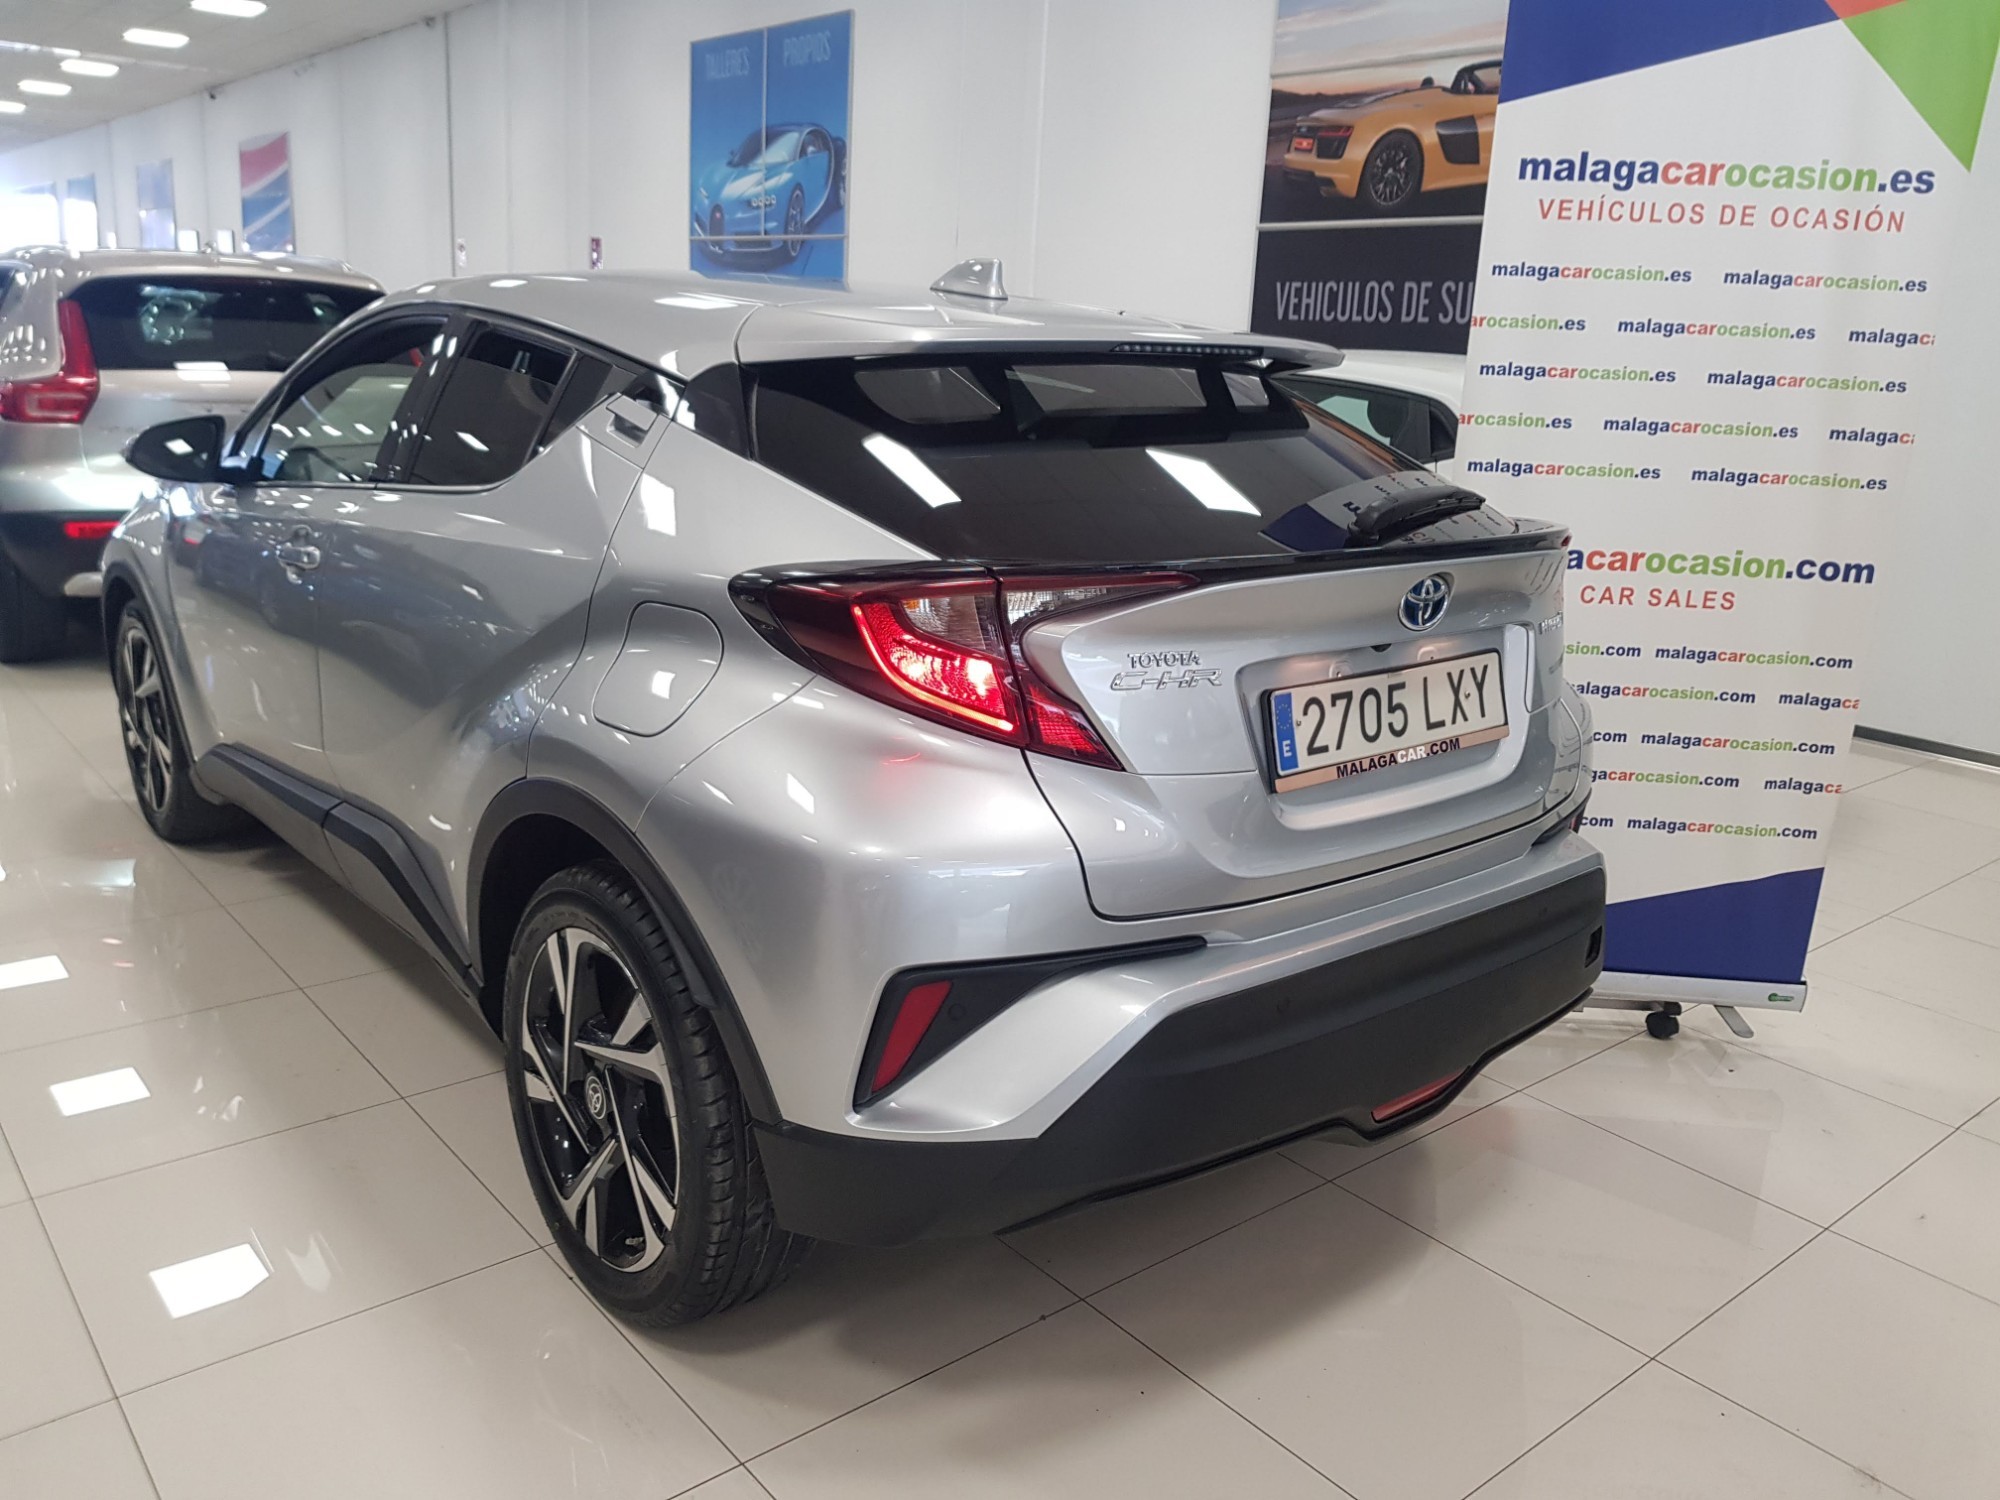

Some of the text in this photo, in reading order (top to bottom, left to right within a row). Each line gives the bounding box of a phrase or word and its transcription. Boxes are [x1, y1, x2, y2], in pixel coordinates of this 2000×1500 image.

[1518, 151, 1935, 194] malagacarocasion.es
[1539, 194, 1904, 232] VEHÍCULOS DE OCASIÓN
[1492, 261, 1927, 292] malagacarocasion.es malagacarocasion.es
[1276, 281, 1394, 323] VEHICULOS
[1401, 281, 1432, 323] DE
[1618, 318, 1815, 340] malagacarocasion.es
[1479, 362, 1907, 393] malagacarocasion.es malagacarocasion.es
[1604, 417, 1798, 438] malagacarocasion.es
[1467, 458, 1887, 490] malagacarocasion.es malagacarocasion.es
[1580, 585, 1735, 610] CAR SALES
[1127, 650, 1201, 669] TOYOTA
[1655, 646, 1853, 669] malagacarocasion.com
[1110, 669, 1222, 691] C-HR
[1573, 680, 1756, 704] alagacarocasion.com
[1302, 664, 1489, 756] 2705 LXY
[1283, 740, 1292, 757] E
[1641, 732, 1835, 755] malagacarocasion.com
[1336, 737, 1460, 779] MALAGACAR.COM
[1627, 817, 1817, 839] malagacarocasion.com
